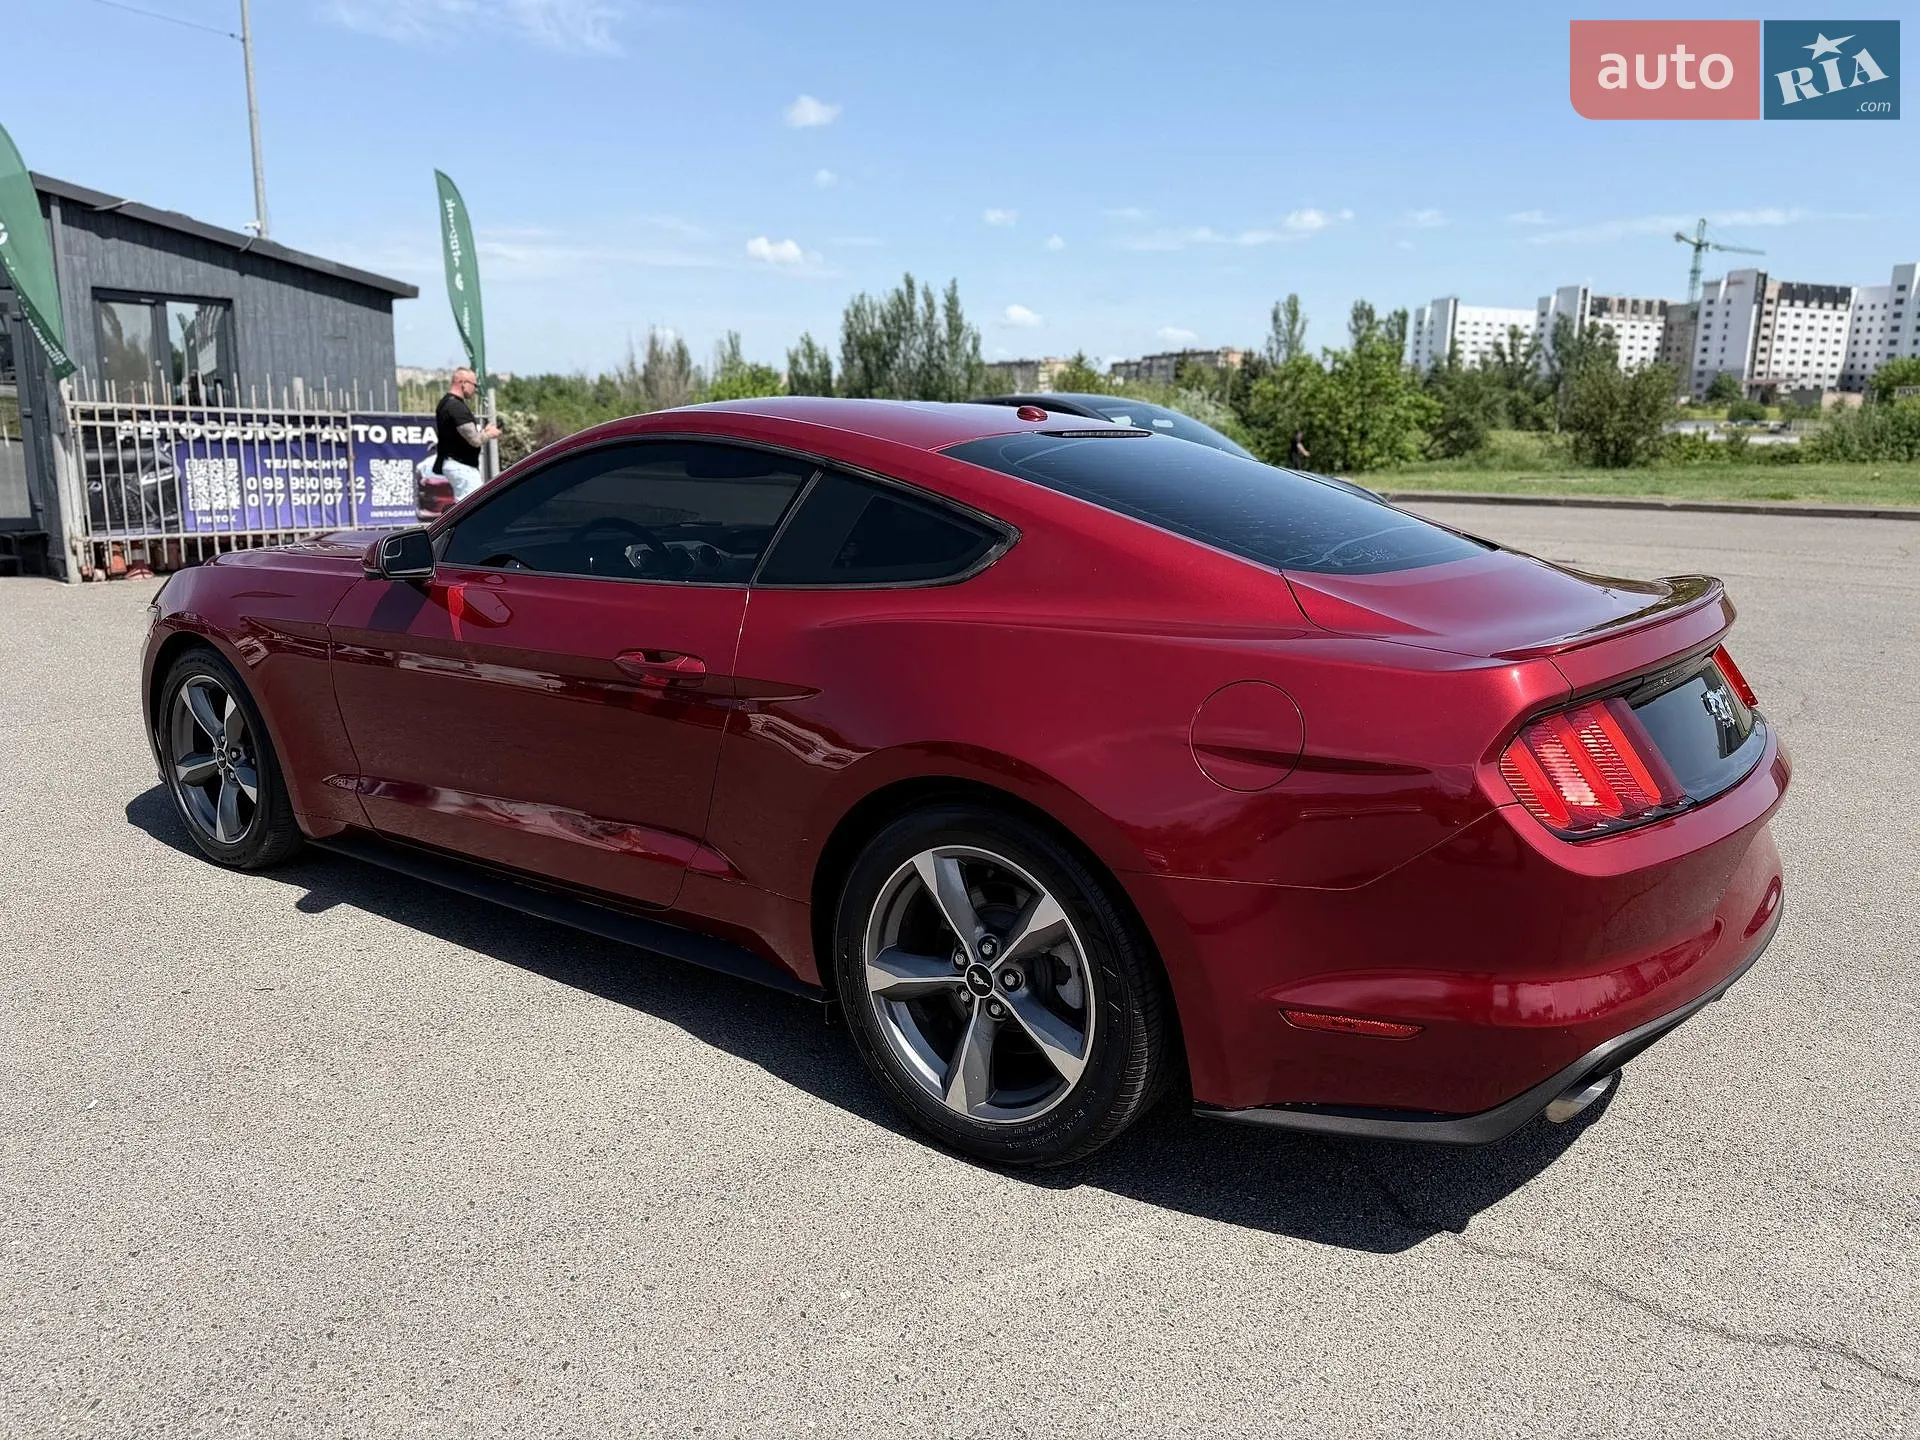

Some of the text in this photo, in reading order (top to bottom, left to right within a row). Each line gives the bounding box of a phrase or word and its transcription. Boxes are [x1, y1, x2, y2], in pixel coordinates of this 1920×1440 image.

[391, 426, 439, 444] REA
[247, 477, 257, 490] 0
[262, 477, 284, 490] 98
[248, 493, 259, 507] 0
